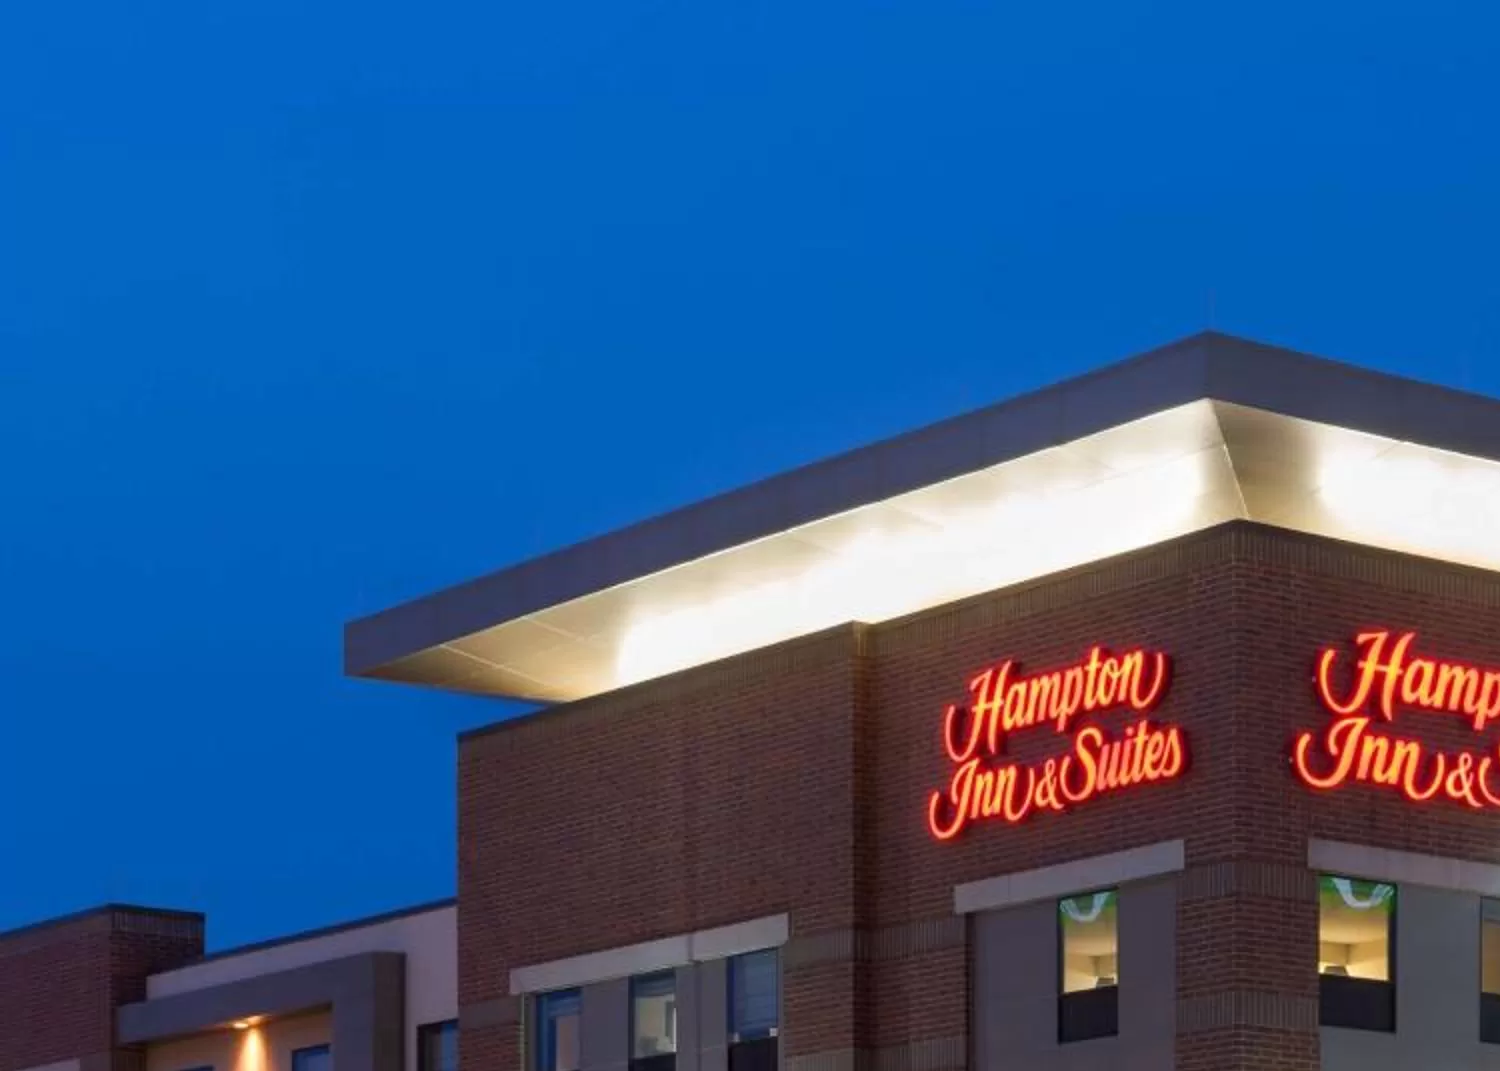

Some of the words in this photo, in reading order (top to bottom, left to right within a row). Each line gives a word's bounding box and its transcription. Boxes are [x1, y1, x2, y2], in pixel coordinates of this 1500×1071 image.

[944, 645, 1166, 763] Hampton
[1296, 717, 1446, 800] Inn
[1445, 752, 1485, 808] &
[928, 757, 1036, 839] Inn
[1035, 758, 1066, 810] &
[1059, 719, 1183, 801] Suites
